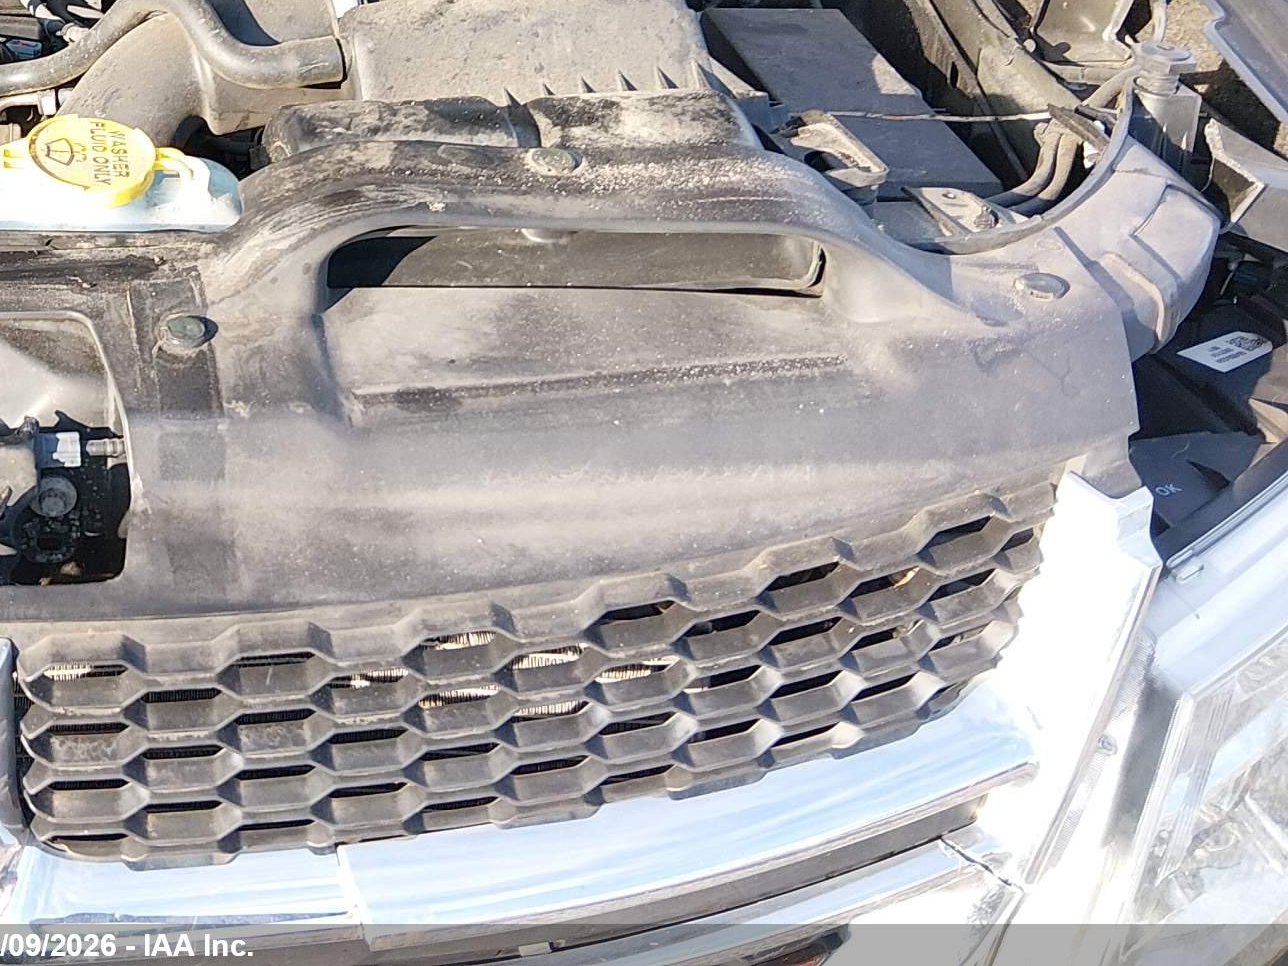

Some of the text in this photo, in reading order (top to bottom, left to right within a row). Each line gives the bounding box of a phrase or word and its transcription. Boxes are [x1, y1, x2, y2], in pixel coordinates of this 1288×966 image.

[89, 121, 111, 186] FLUID ONLY
[107, 130, 130, 178] WASHER
[1155, 483, 1183, 495] OK
